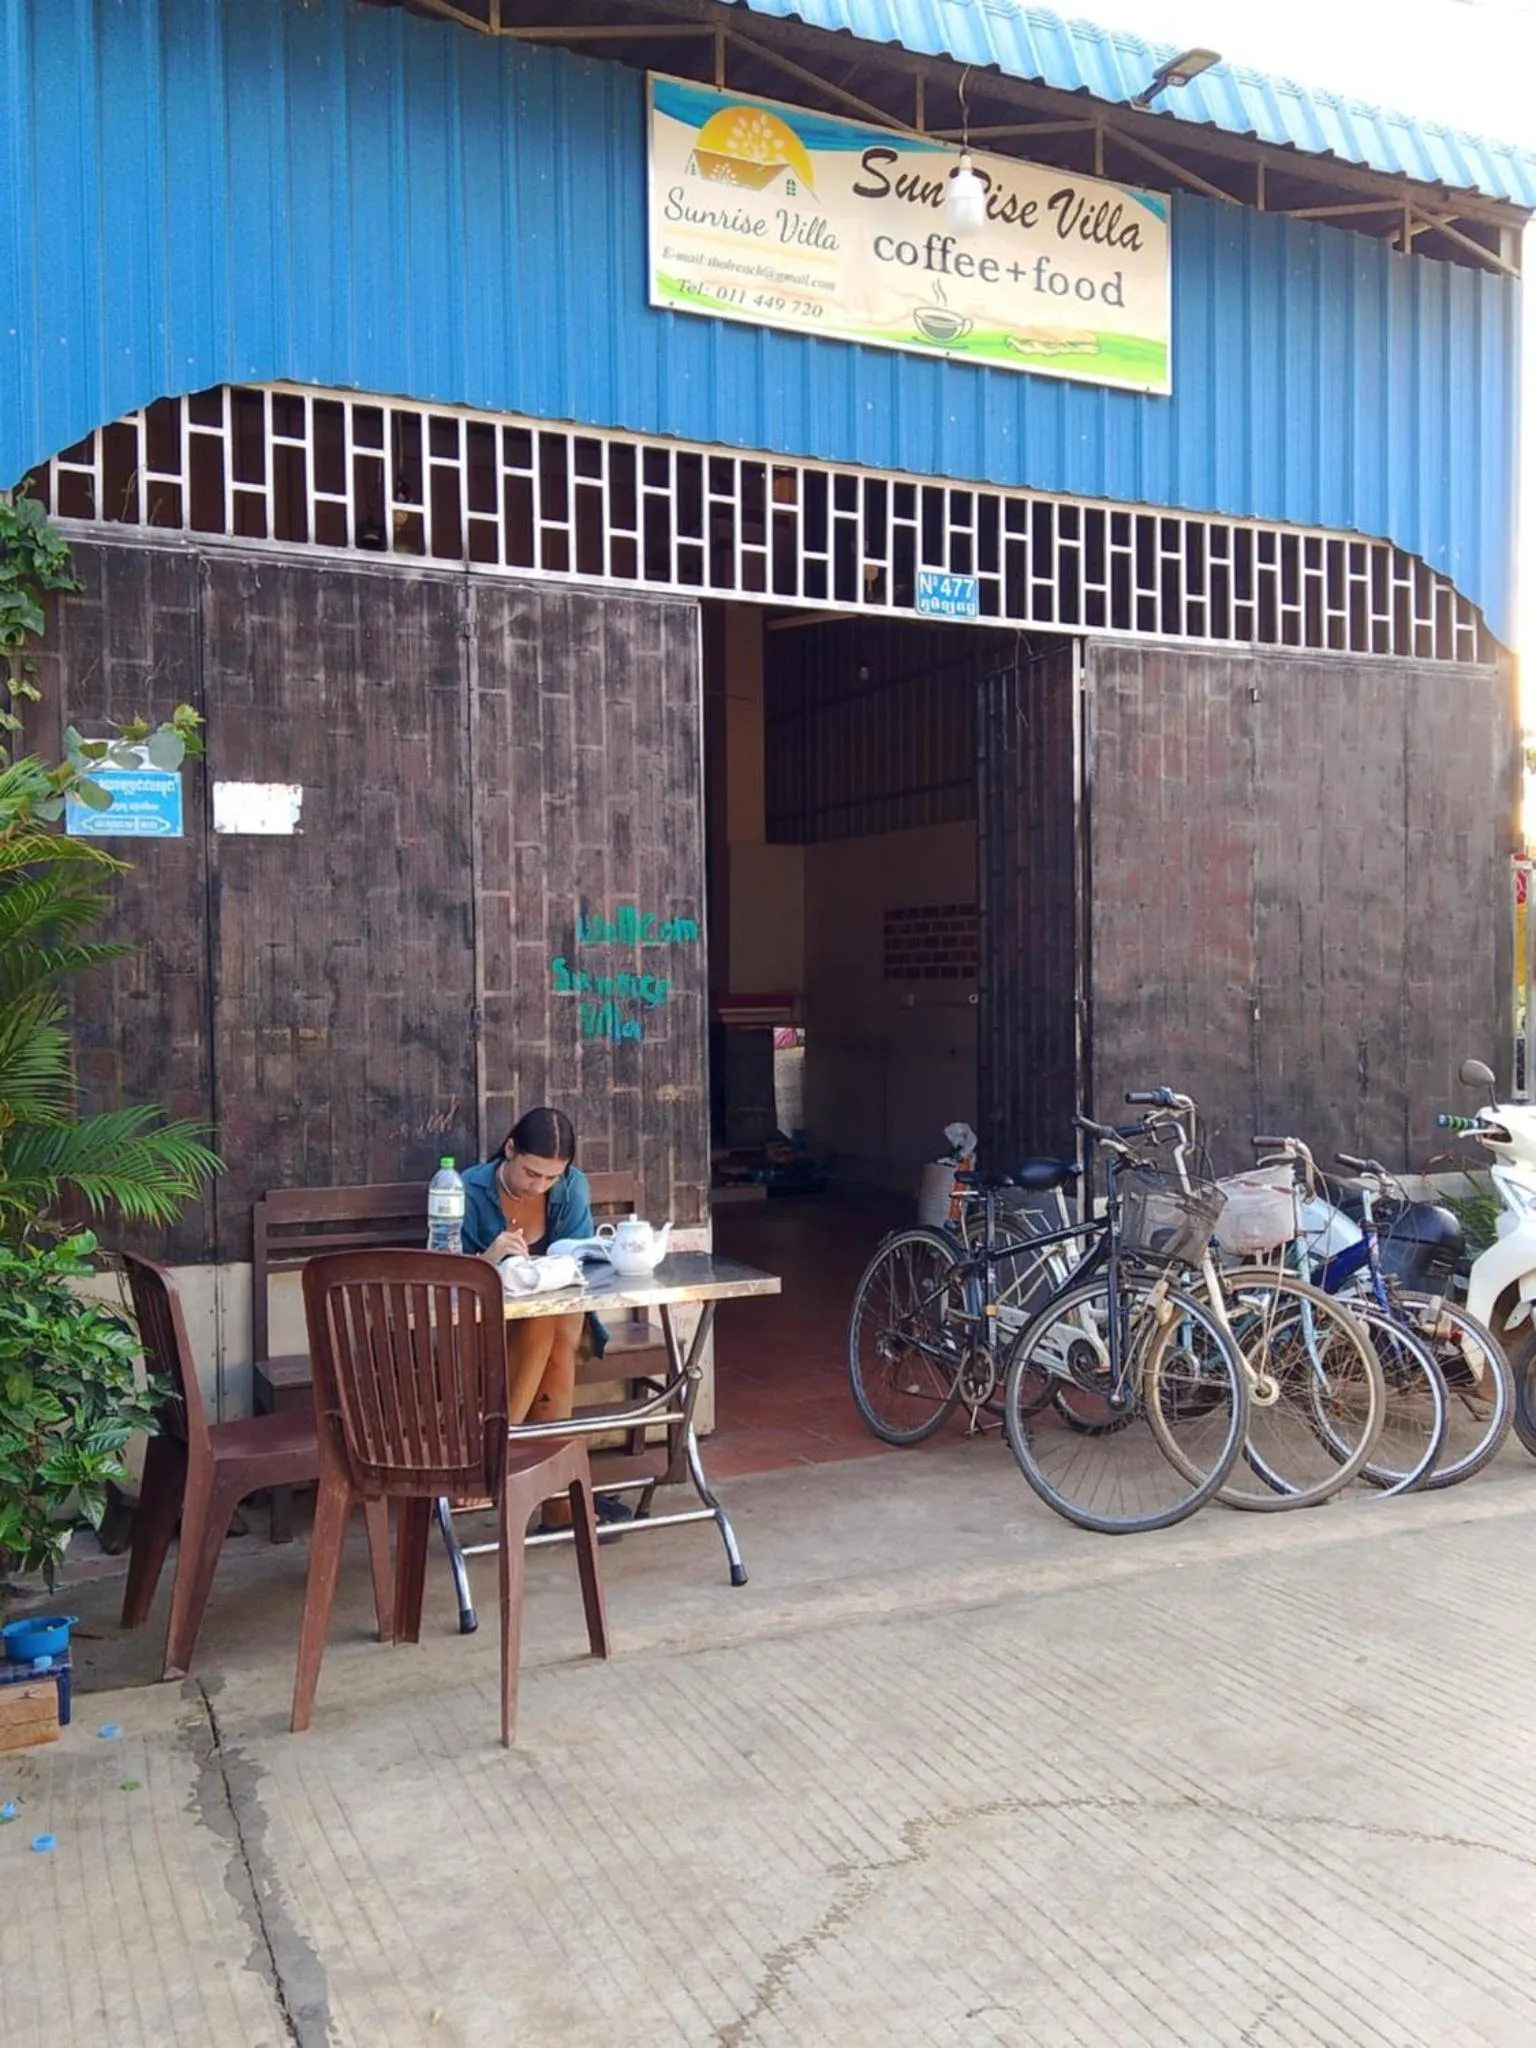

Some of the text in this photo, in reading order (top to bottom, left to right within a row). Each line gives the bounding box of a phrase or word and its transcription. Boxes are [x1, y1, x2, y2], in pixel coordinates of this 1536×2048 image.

[664, 186, 840, 251] Sunrise Villa
[1047, 188, 1143, 252] Villa
[716, 286, 747, 304] 011
[753, 294, 786, 311] 449
[792, 300, 825, 318] 720
[873, 233, 1126, 308] coffee+food
